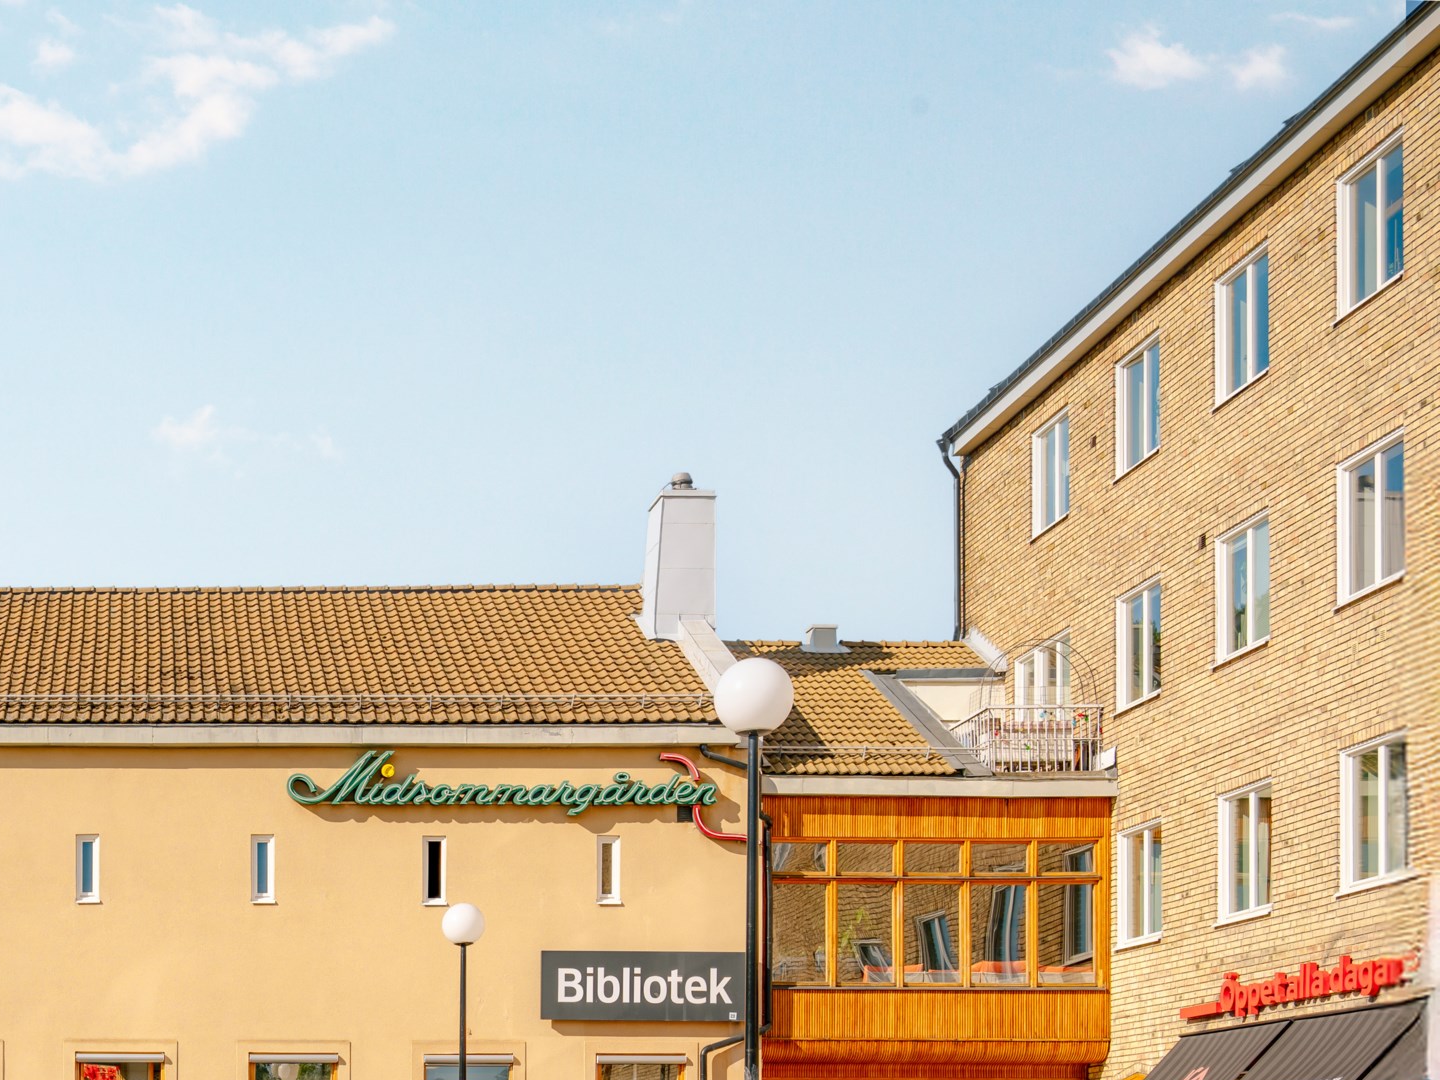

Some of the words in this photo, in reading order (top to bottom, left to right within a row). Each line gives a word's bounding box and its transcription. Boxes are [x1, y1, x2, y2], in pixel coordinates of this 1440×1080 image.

[287, 750, 717, 816] Midsommargården
[557, 966, 733, 1004] Bibliotek
[1220, 971, 1287, 1017] Öppet
[1286, 962, 1329, 1001] alla
